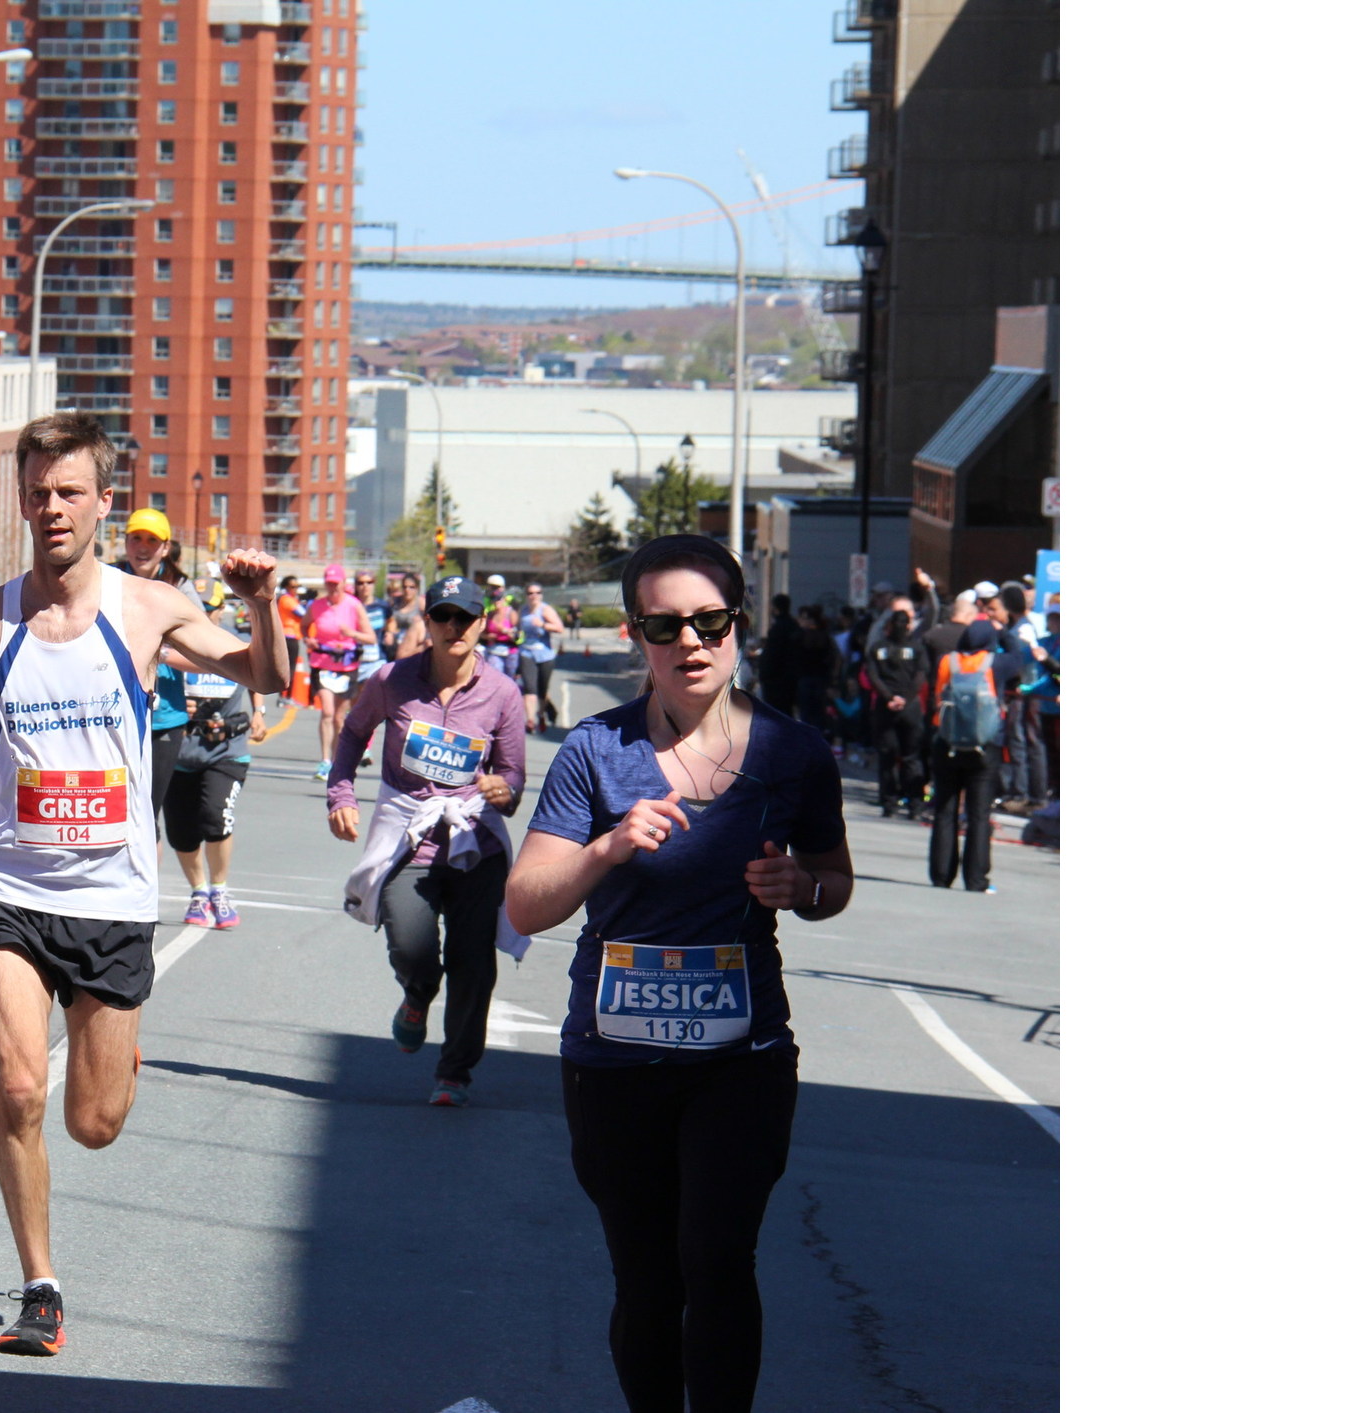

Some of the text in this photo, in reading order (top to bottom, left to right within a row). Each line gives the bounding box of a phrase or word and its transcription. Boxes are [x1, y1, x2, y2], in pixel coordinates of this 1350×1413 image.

[5, 699, 77, 715] Bluenose
[7, 715, 122, 736] Physiotherapy
[418, 743, 467, 768] JOAN
[425, 764, 454, 780] 1146
[38, 797, 107, 819] GREG
[56, 826, 91, 842] 104
[625, 969, 658, 977] Scotiabank
[608, 980, 738, 1013] JESSICA
[645, 1019, 705, 1041] 1130
